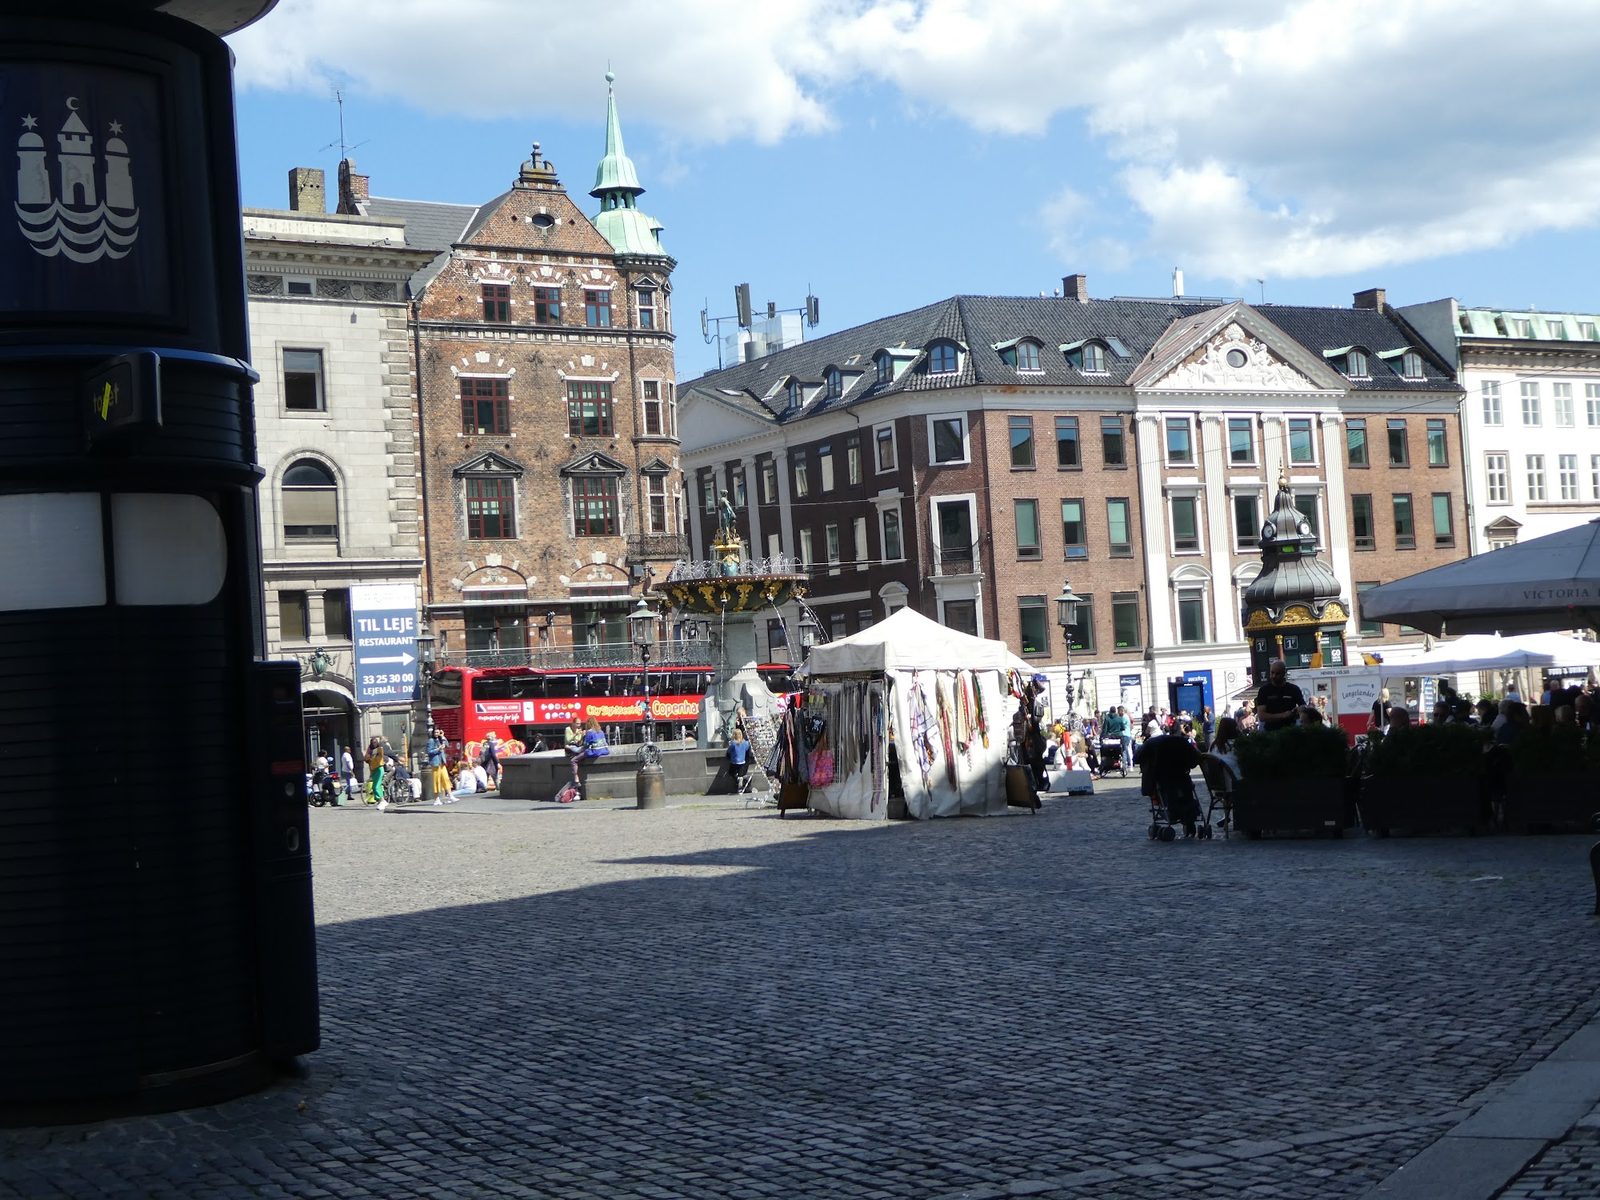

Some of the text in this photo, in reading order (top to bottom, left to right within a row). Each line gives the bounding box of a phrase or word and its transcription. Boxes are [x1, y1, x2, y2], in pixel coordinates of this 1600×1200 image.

[1523, 588, 1589, 600] VICTORIA
[358, 617, 414, 633] TIL LEJE
[358, 636, 414, 647] RESTAURANT
[363, 672, 414, 684] 33 25 30 00
[652, 699, 700, 718] Copenha
